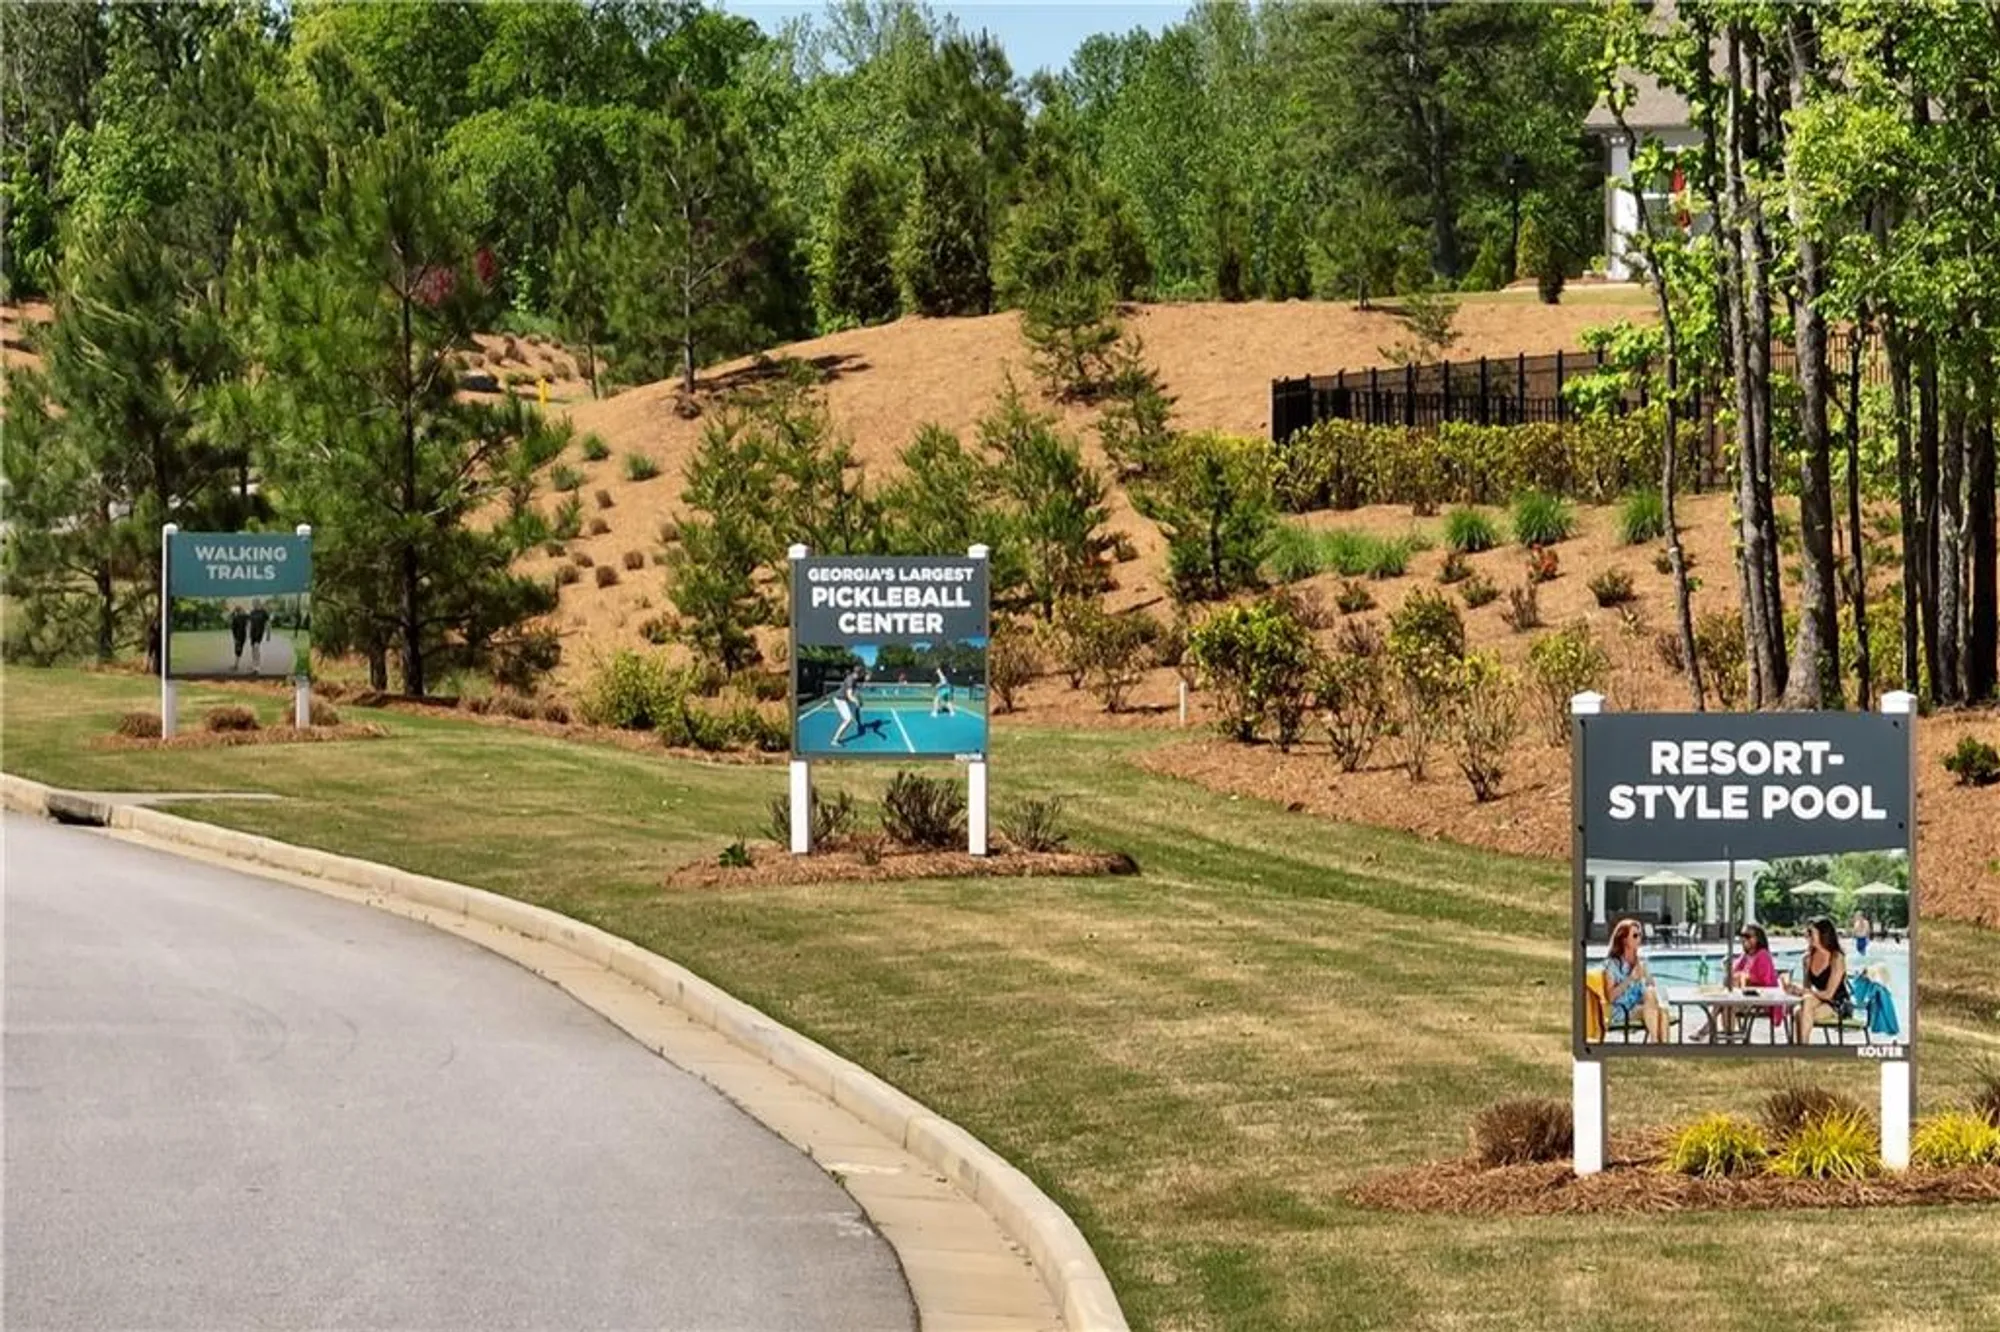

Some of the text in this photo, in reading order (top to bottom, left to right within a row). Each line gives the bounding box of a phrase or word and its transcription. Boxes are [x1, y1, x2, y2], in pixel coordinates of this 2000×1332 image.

[195, 546, 287, 562] WALKING
[206, 565, 276, 580] TRAILS
[808, 568, 974, 582] GEORGIA'S LARGEST
[812, 587, 971, 608] PICKLEBALL
[838, 613, 943, 634] CENTER
[1651, 741, 1845, 776] RESORT-
[1609, 785, 1887, 820] STYLE POOL
